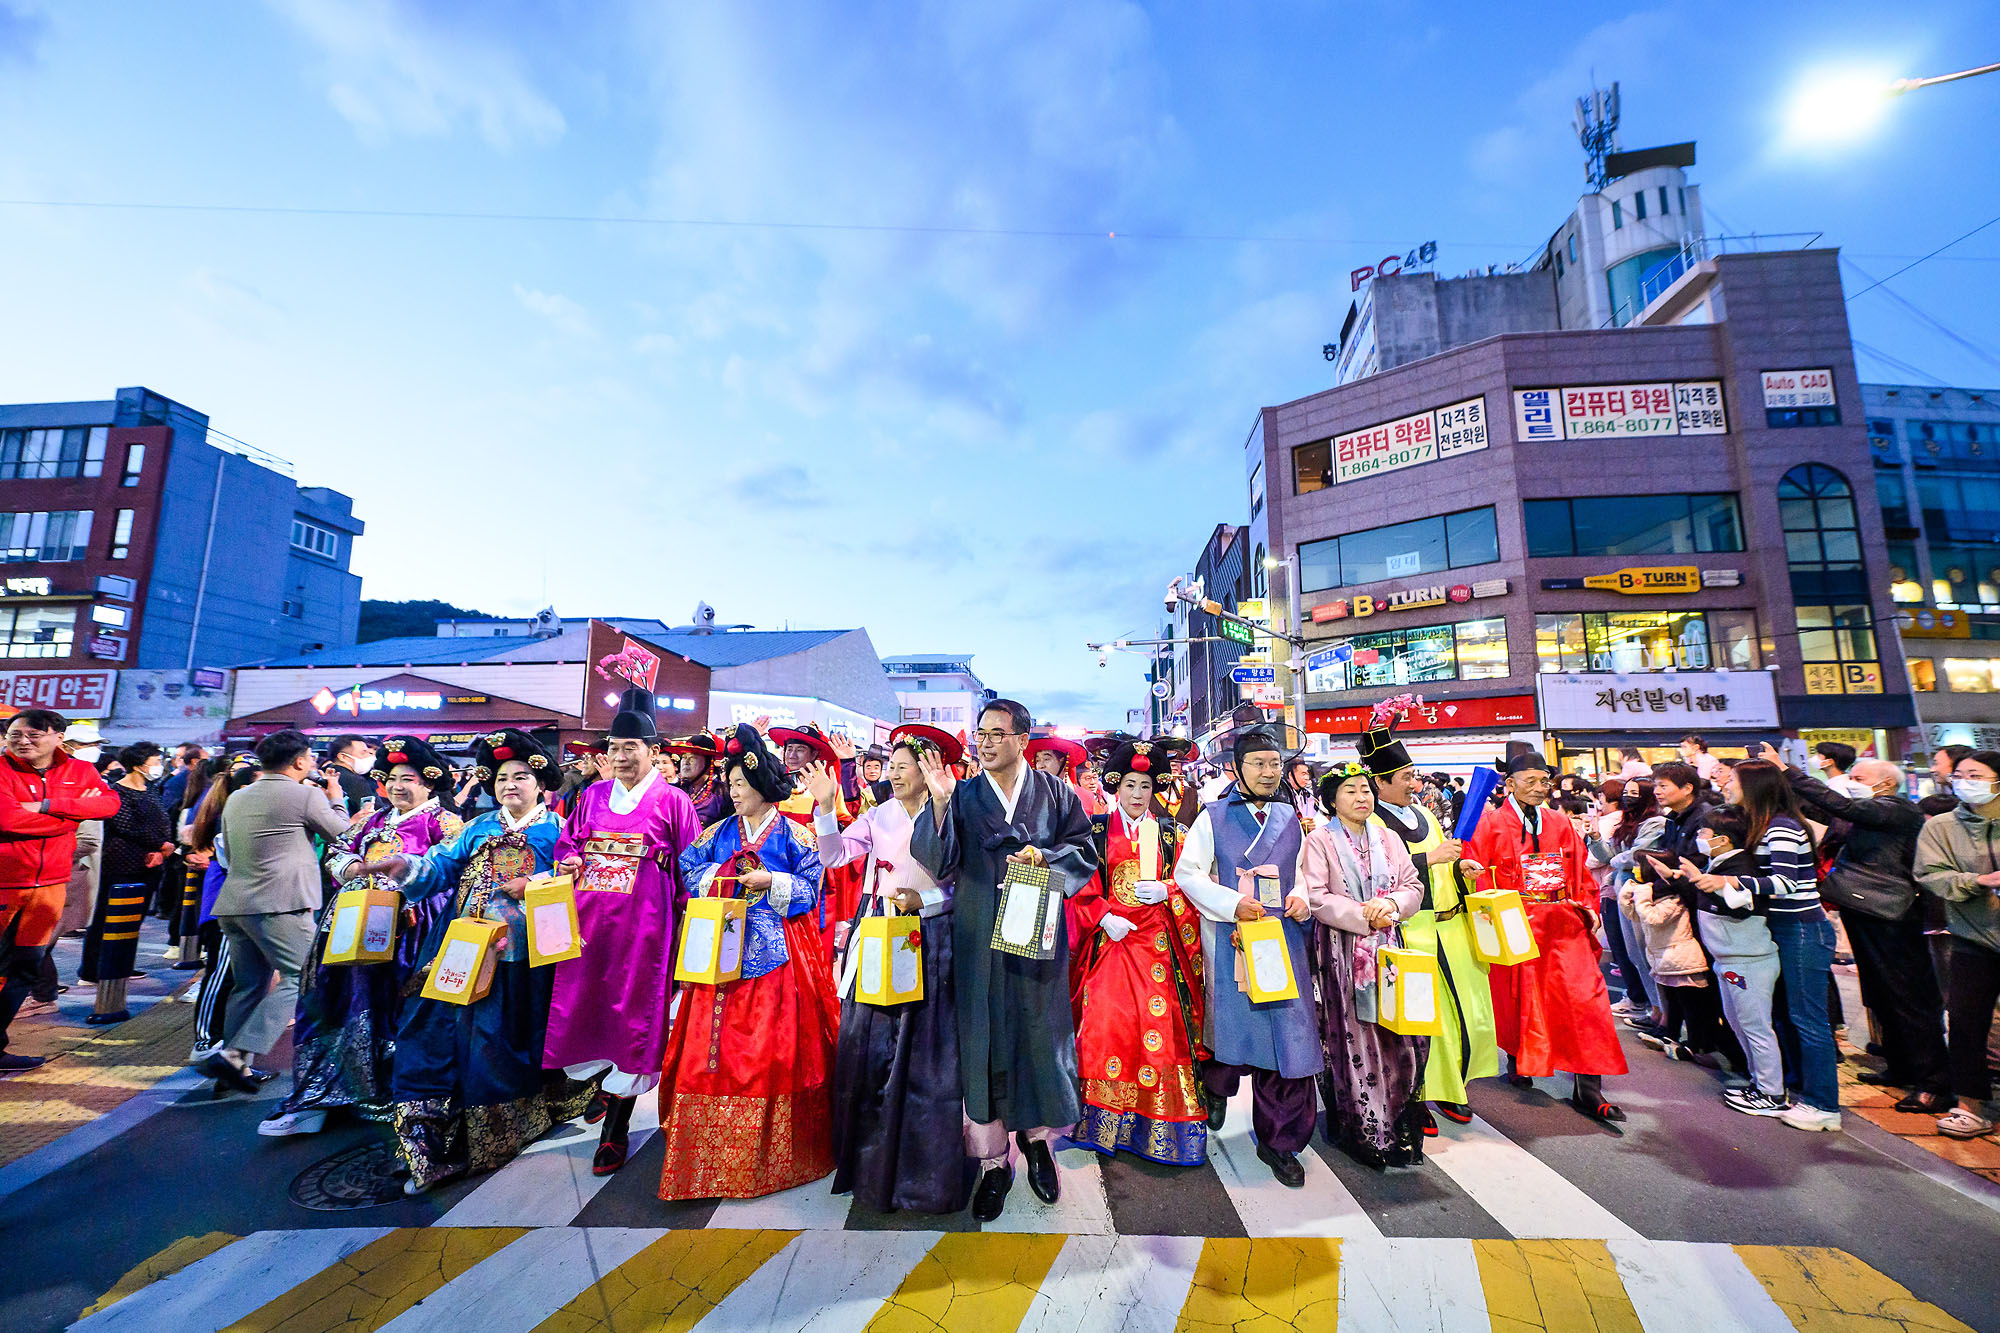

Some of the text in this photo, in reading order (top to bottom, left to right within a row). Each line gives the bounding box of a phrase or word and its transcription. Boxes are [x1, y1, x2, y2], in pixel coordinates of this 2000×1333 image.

[1766, 374, 1828, 390] Auto CAD
[1567, 388, 1671, 417] 컴퓨터 학원
[1678, 387, 1719, 405] 자격증
[1441, 404, 1480, 429] 자격증
[1522, 391, 1556, 438] 엘리트
[1570, 417, 1673, 434] T.864-8077
[1678, 409, 1724, 429] 전문학원
[1339, 416, 1431, 462] 컴퓨터 학원
[1440, 424, 1484, 452] 전문학원
[1340, 444, 1432, 477] T.864-8077
[1642, 571, 1687, 583] TURN
[1388, 585, 1446, 605] TURN
[1251, 668, 1273, 677] 망운로
[14, 677, 105, 707] 현대약국
[1596, 687, 1729, 713] 자연말이 김밥
